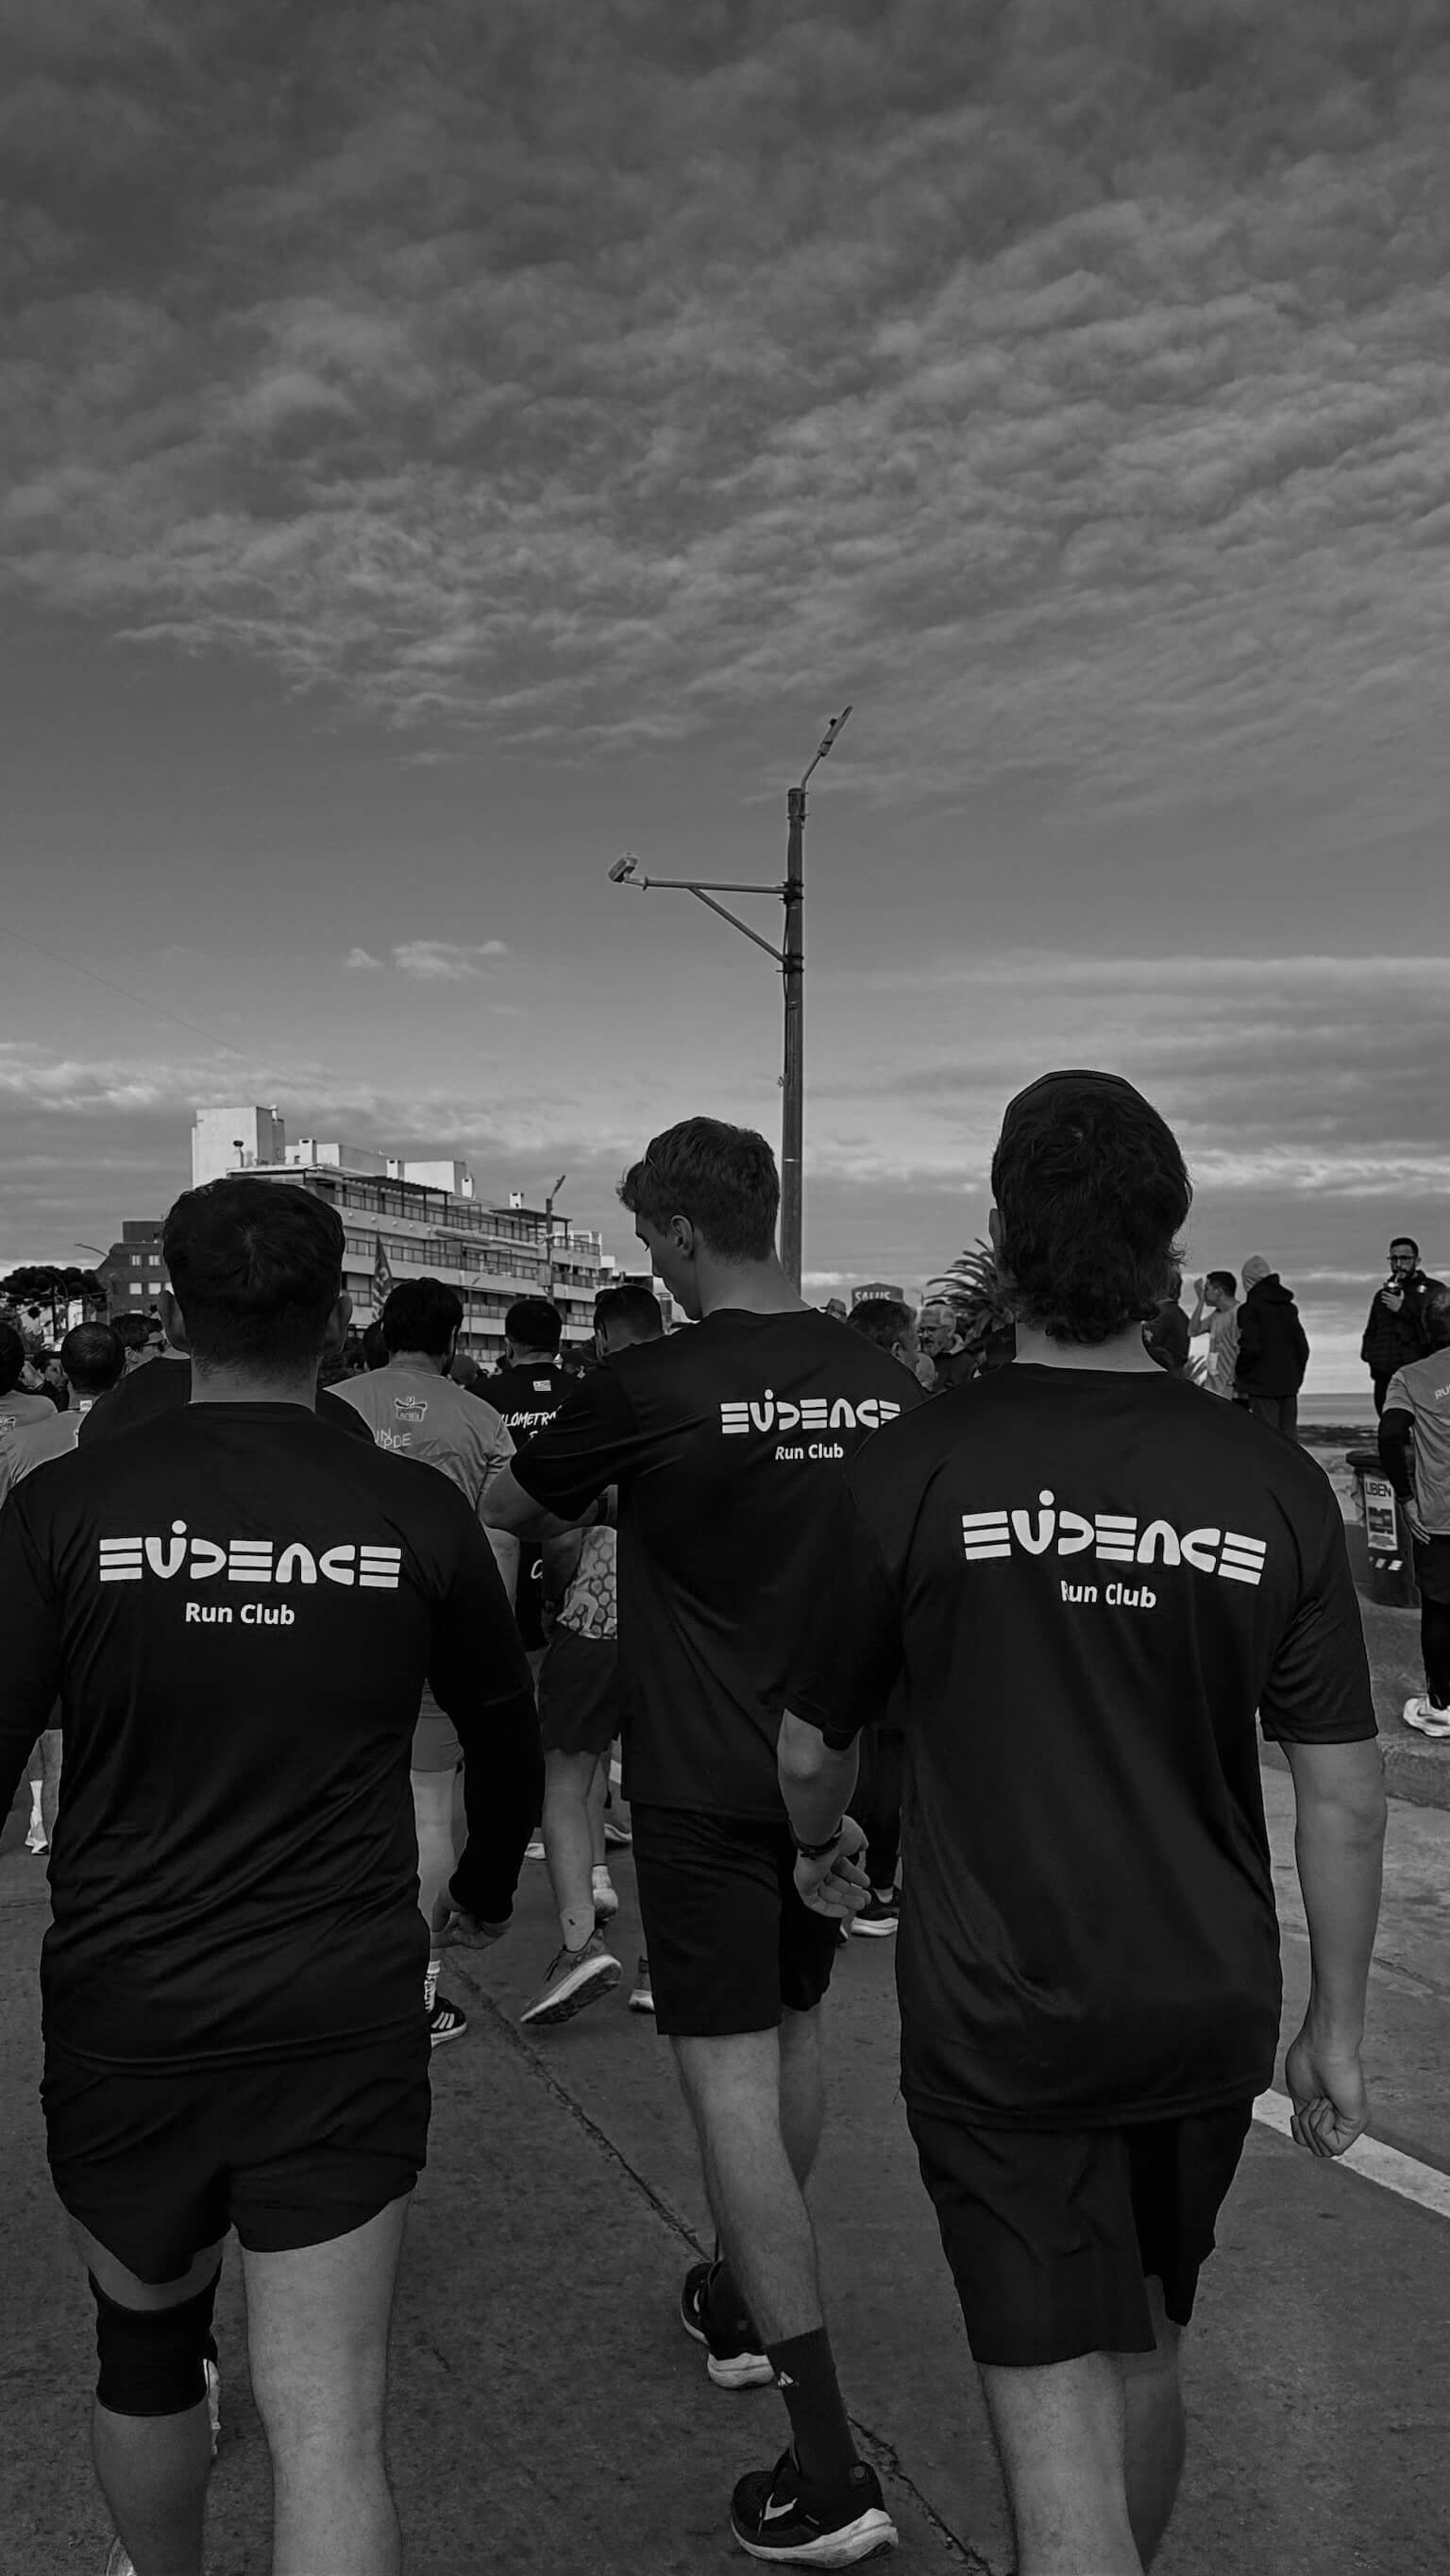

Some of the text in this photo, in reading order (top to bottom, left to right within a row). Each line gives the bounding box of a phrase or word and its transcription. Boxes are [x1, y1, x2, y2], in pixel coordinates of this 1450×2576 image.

[774, 1443, 844, 1461] Run Club
[961, 1489, 1268, 1586] EVIDENCE
[99, 1519, 402, 1589] EVIDENCE
[1060, 1580, 1157, 1609] Run Club
[185, 1602, 295, 1625] Run Club
